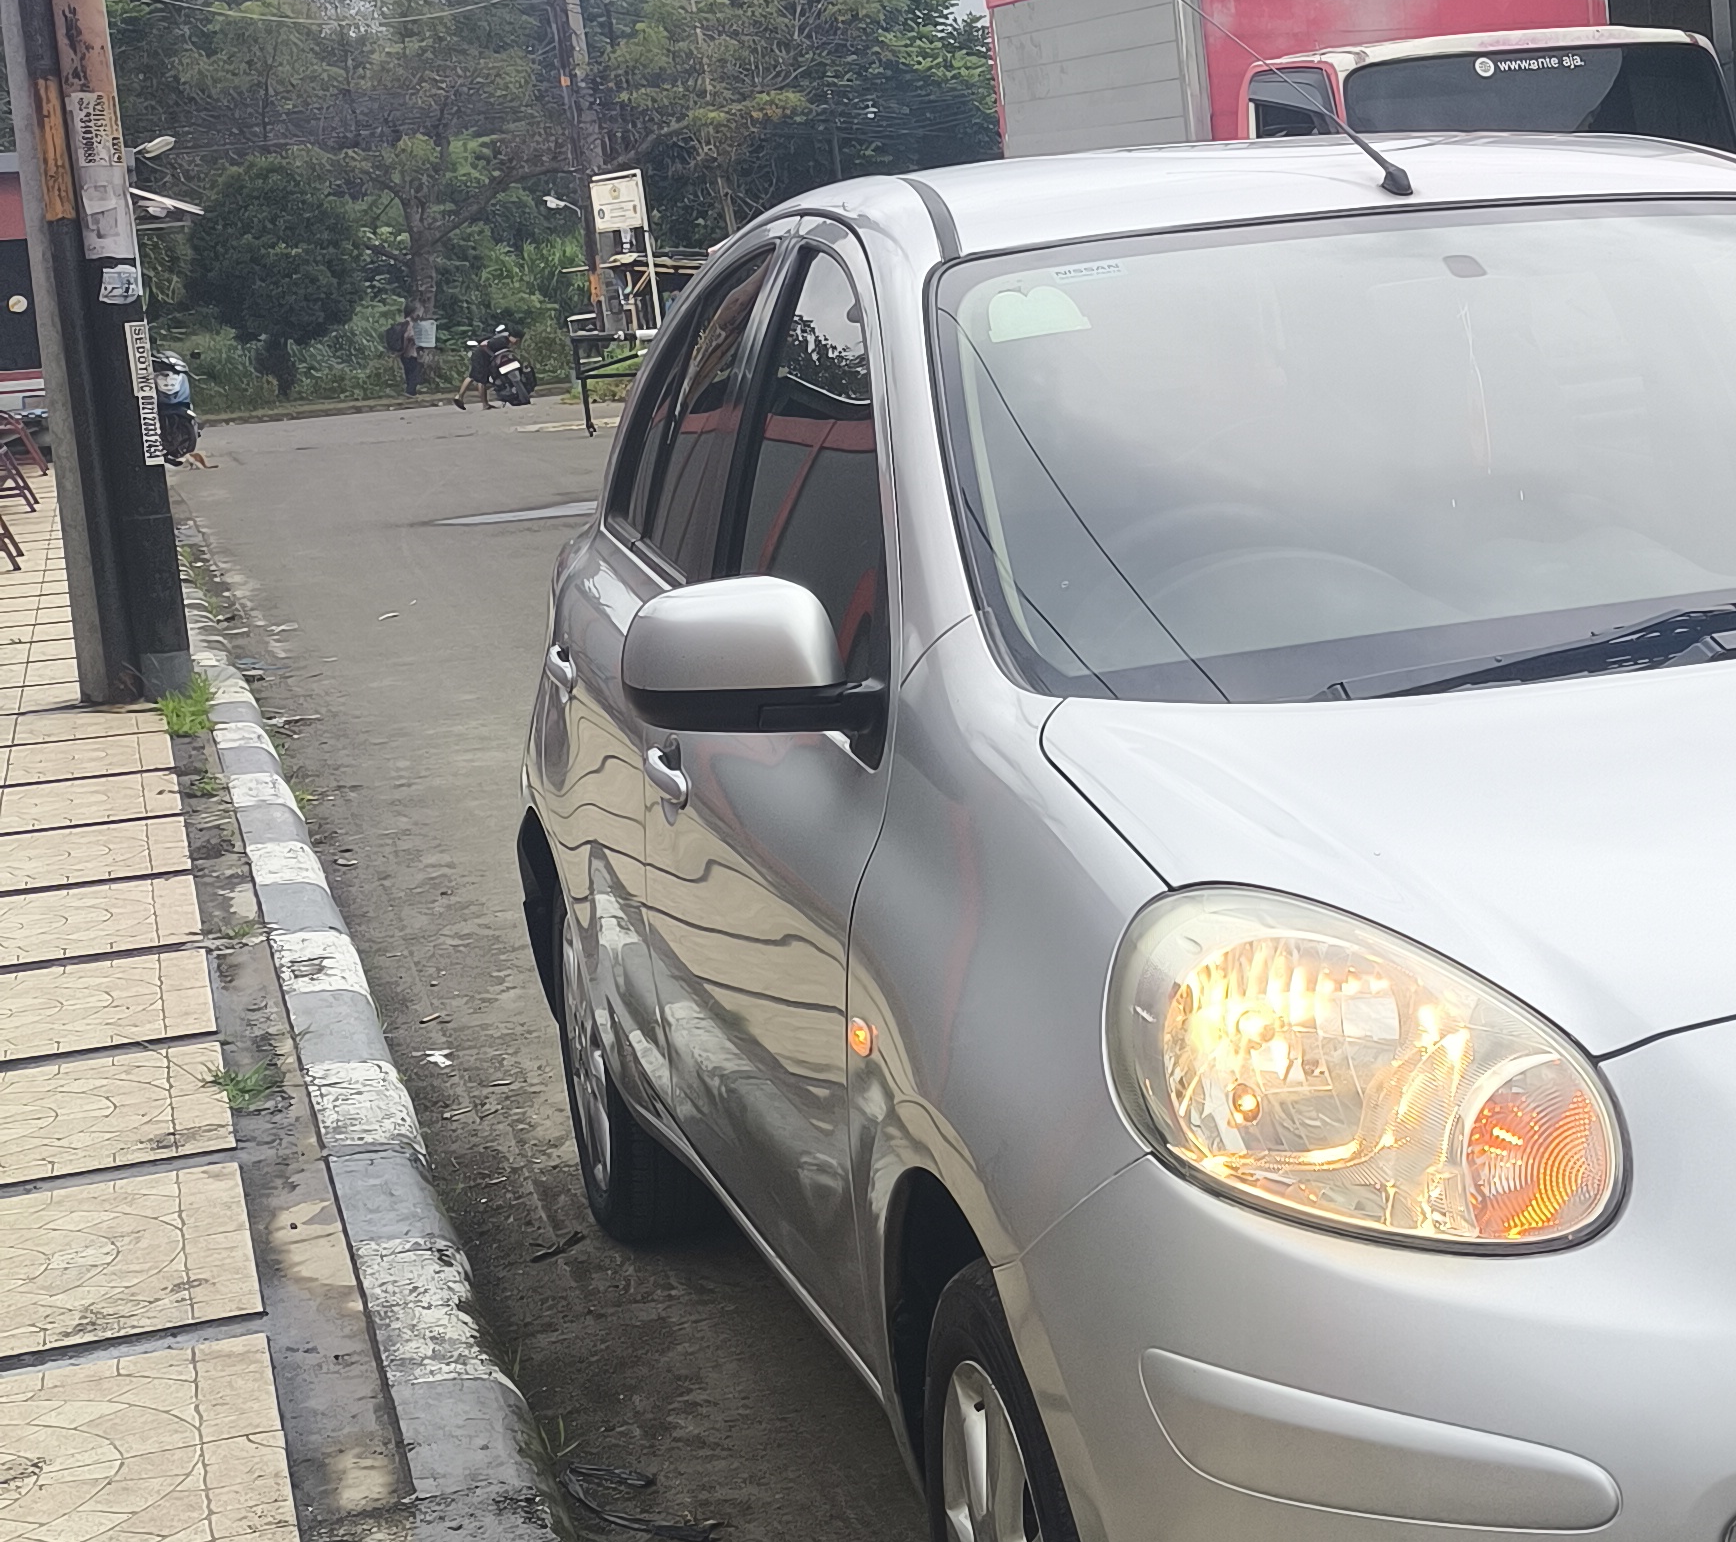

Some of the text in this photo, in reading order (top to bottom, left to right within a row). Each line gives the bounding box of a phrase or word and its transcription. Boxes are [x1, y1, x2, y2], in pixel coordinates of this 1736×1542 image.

[1055, 263, 1120, 277] NISSAN
[133, 327, 149, 373] SEDOT
[138, 373, 154, 394] WC
